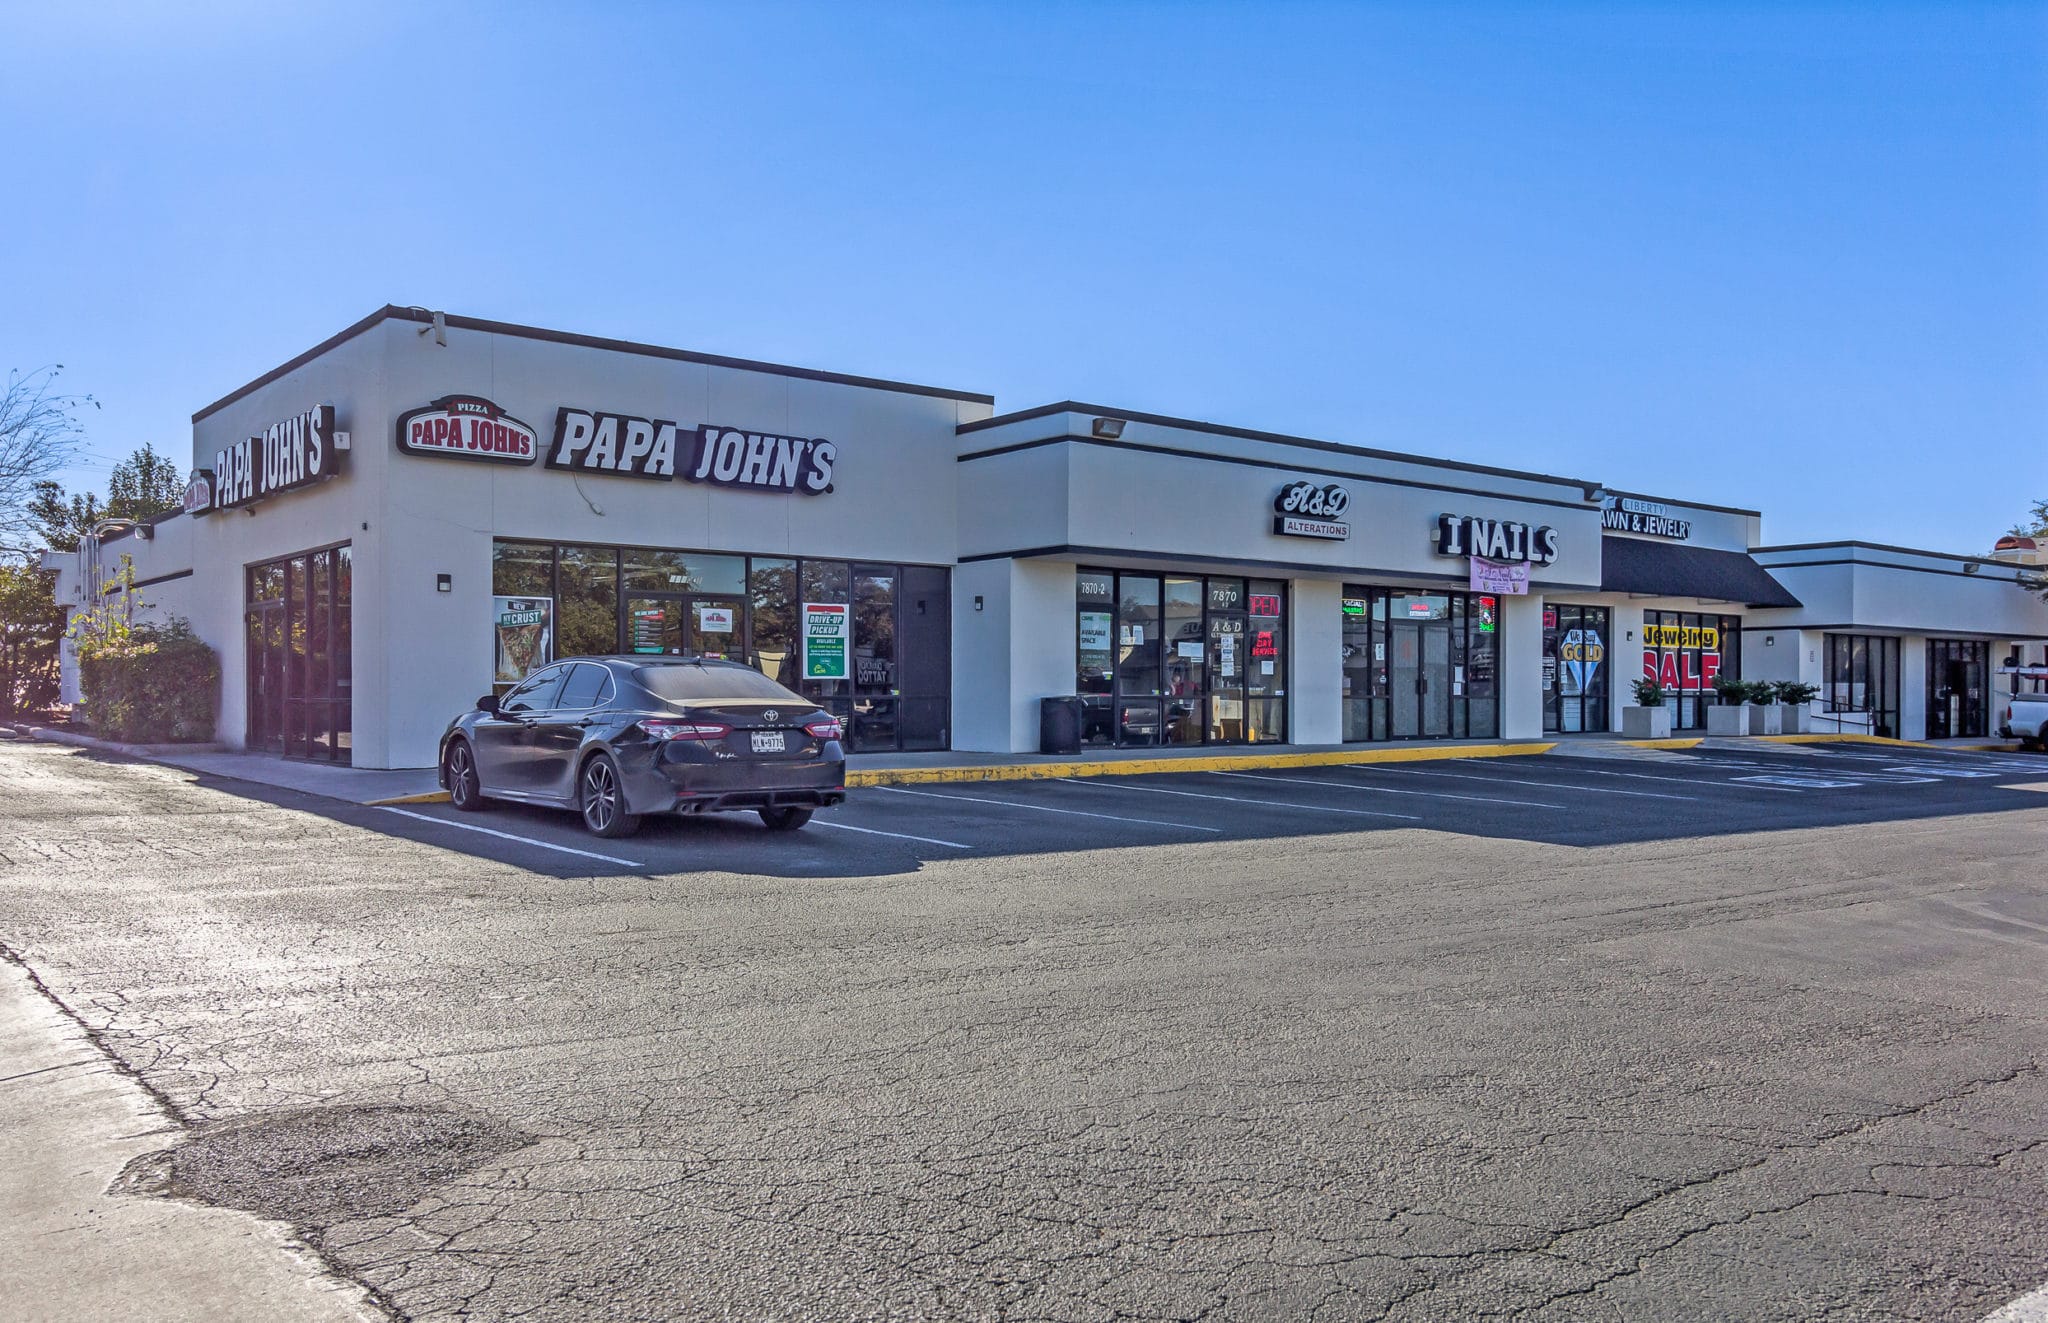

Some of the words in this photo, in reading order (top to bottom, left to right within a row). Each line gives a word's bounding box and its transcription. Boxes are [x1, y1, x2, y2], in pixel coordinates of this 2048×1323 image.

[457, 403, 488, 414] PIZZA
[412, 418, 463, 448] PAPA
[467, 420, 530, 455] JOHN'S
[215, 437, 253, 508] PAPA
[261, 404, 322, 493] JOHN'S
[555, 412, 676, 476] PAPA
[695, 429, 837, 490] JOHN'S
[1624, 500, 1665, 515] LIBERTY
[1287, 521, 1347, 536] ALTERATIONS
[1600, 510, 1628, 530] AWN
[1632, 514, 1641, 532] &
[1643, 516, 1691, 538] JEWELRY
[1447, 517, 1462, 554] I
[1471, 519, 1560, 563] NAILS
[1213, 590, 1237, 602] 7870
[511, 612, 540, 624] CRUST
[809, 615, 843, 624] DRIVE-UP
[811, 625, 839, 634] PICKUP
[1213, 621, 1219, 632] A
[1222, 621, 1232, 632] &
[1234, 622, 1241, 632] D
[1570, 631, 1580, 641] We
[1643, 627, 1714, 647] Jewelry
[1562, 643, 1604, 662] GOLD
